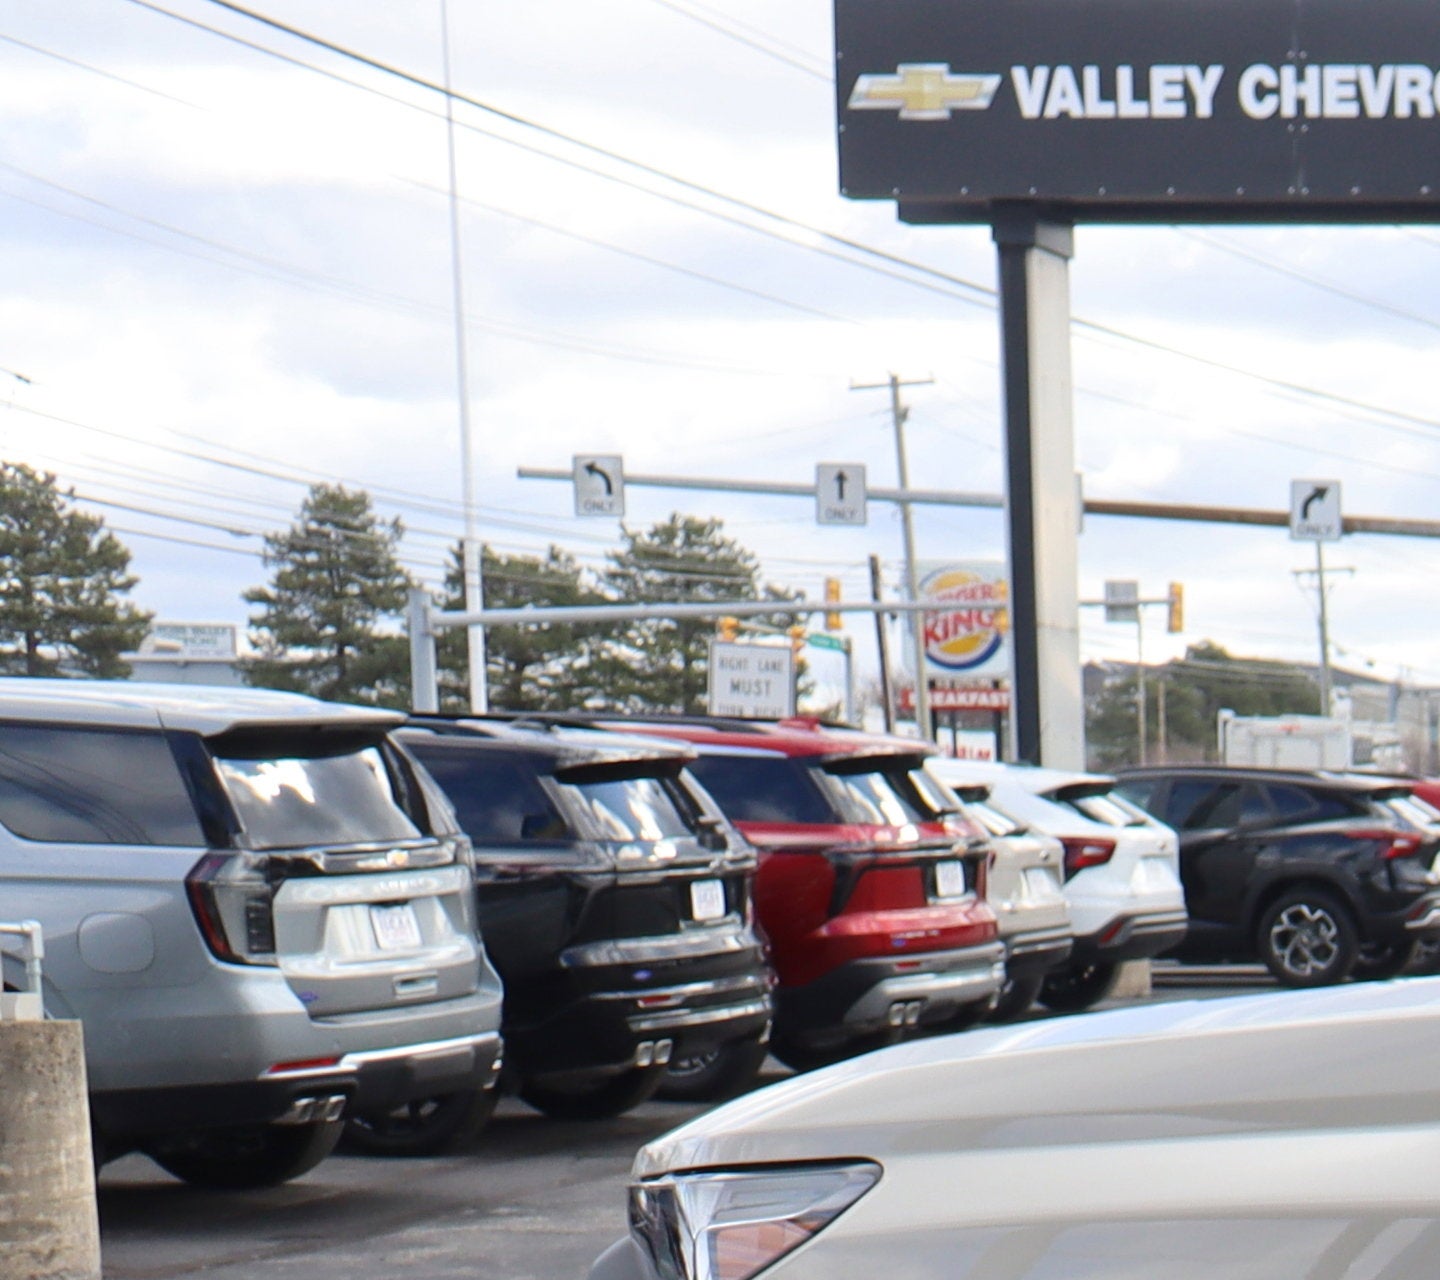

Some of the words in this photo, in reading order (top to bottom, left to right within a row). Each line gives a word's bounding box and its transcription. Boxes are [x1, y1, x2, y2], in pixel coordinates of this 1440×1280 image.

[1010, 64, 1225, 120] VALLEY
[729, 678, 772, 697] MUST
[907, 690, 1009, 707] BEAKFAST
